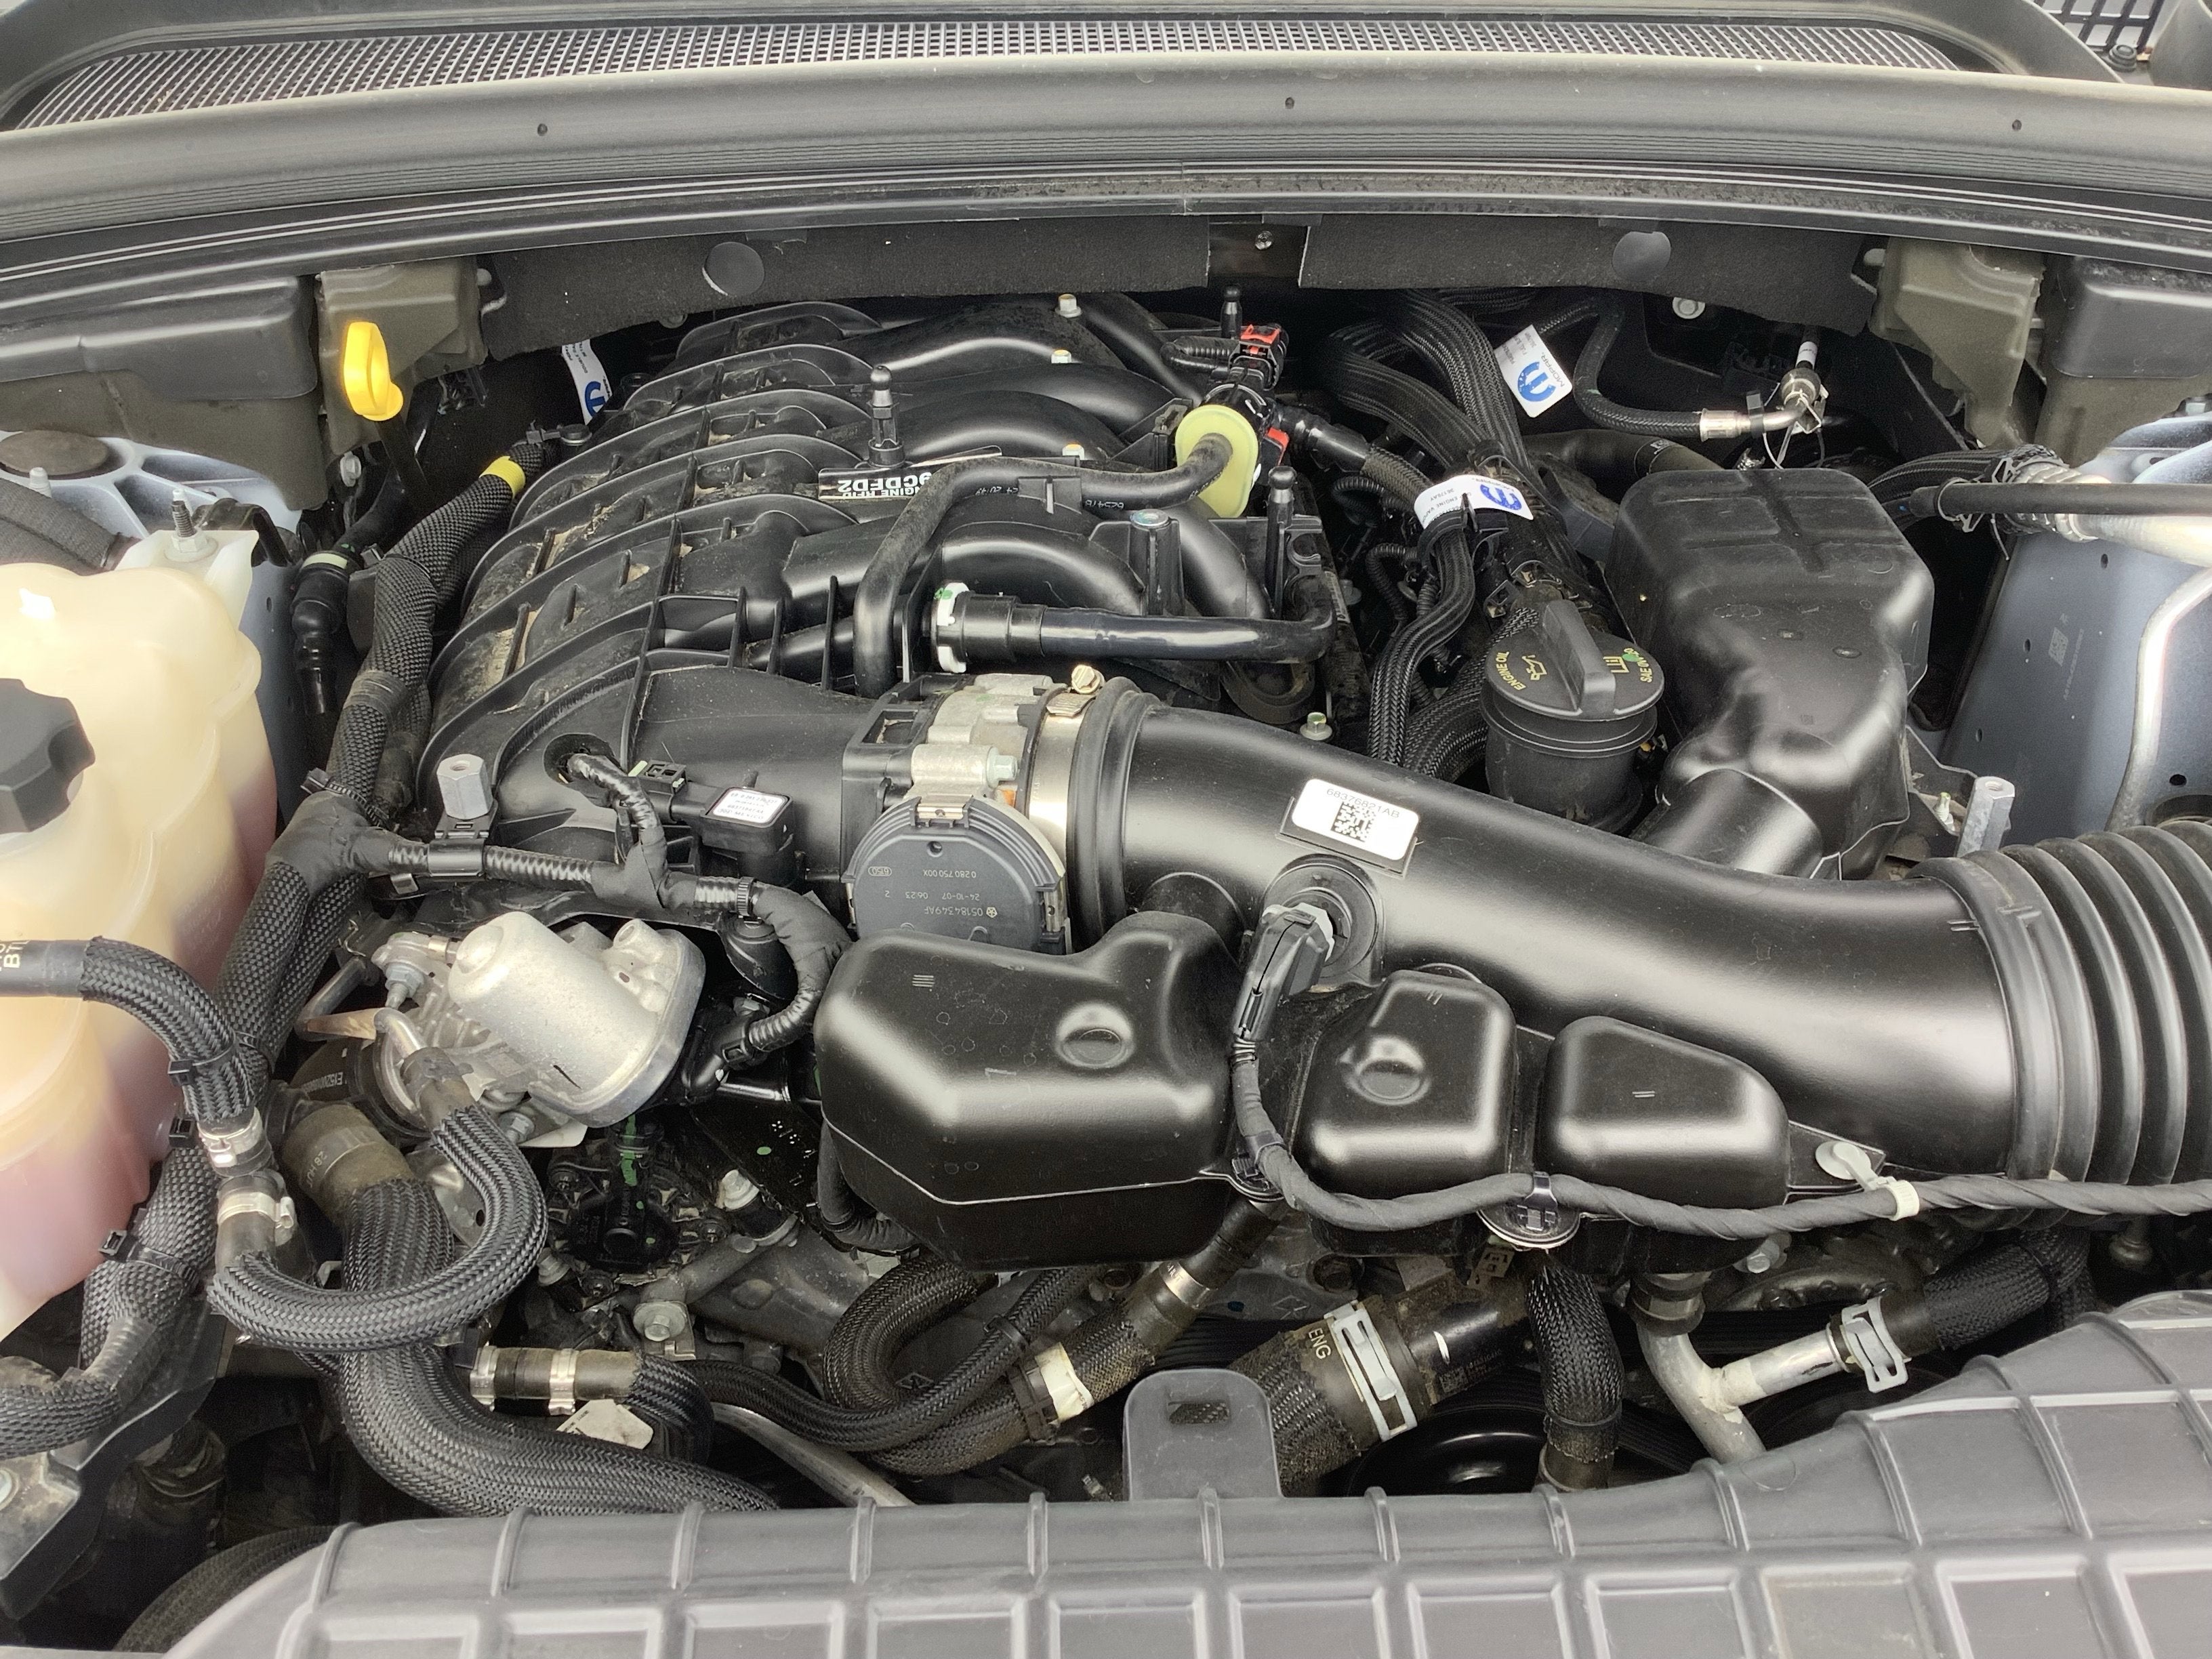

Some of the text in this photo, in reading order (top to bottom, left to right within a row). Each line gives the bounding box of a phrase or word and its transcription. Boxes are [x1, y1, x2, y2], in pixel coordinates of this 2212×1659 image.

[1496, 663, 1526, 691] ENGINE
[1639, 668, 1653, 683] SAE
[1326, 788, 1400, 818] 68376821AB
[1308, 1328, 1332, 1359] ENG
